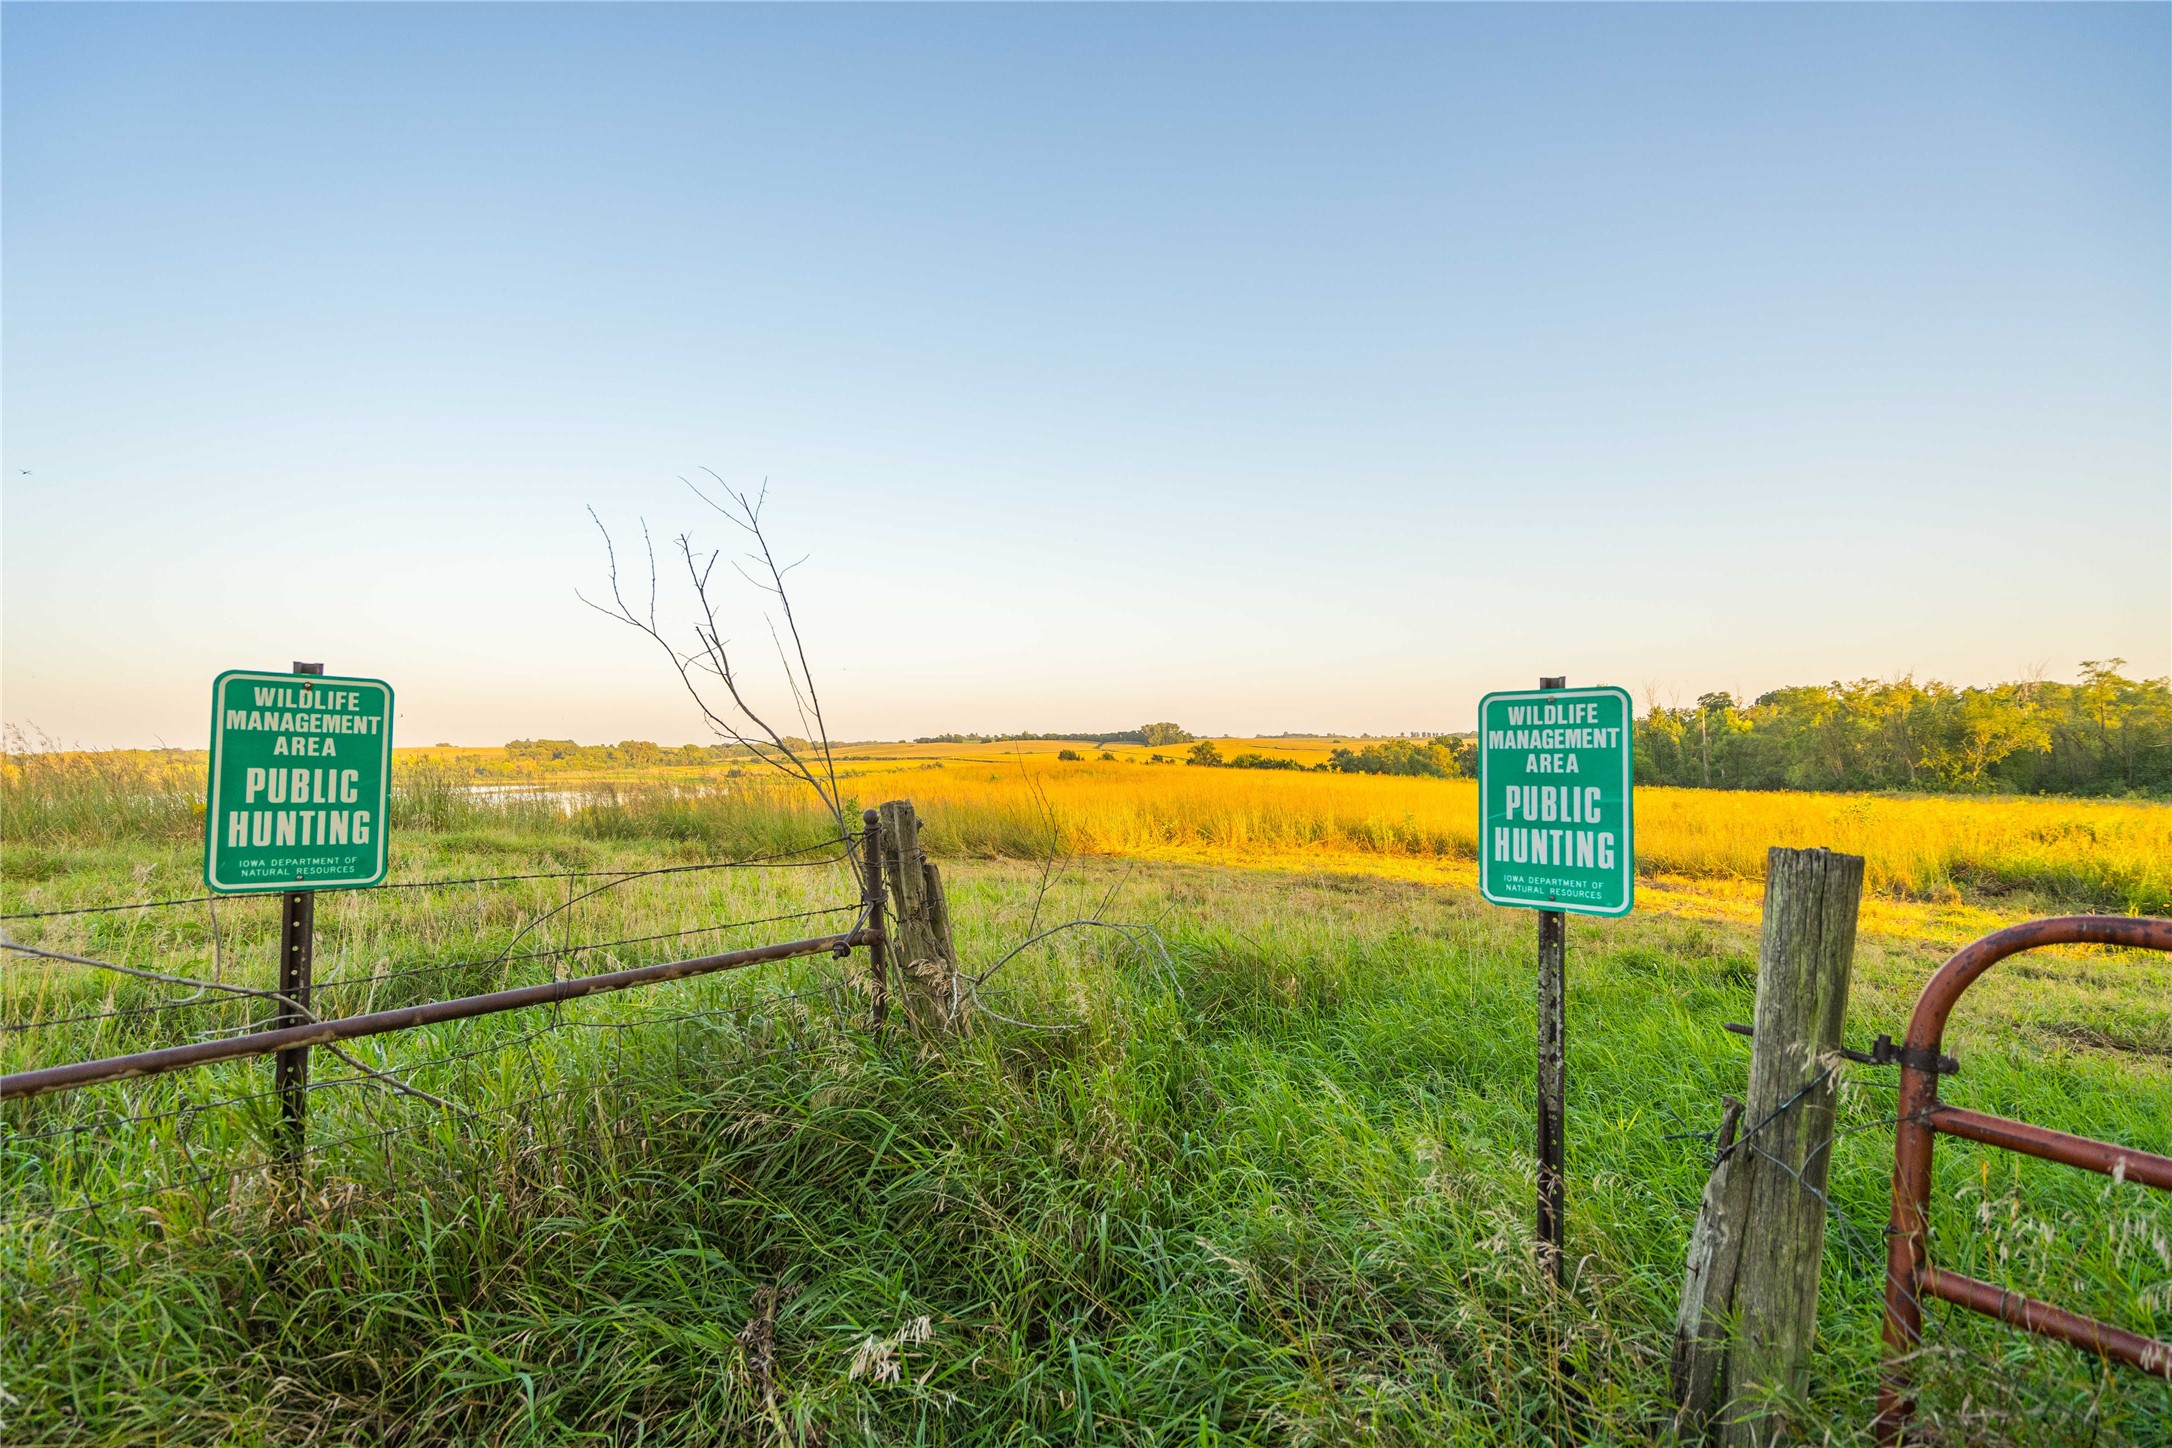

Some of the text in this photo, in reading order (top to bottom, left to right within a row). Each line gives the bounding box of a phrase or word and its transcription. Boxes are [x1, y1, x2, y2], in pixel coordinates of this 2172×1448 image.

[254, 687, 359, 711] WILDLIFE
[226, 710, 381, 734] MANAGEMENT
[1508, 704, 1598, 725] WILDLIFE
[274, 736, 336, 756] AREA
[1489, 728, 1620, 750] MANAGEMENT
[1526, 754, 1579, 773] AREA
[246, 768, 359, 803] PUBLIC
[1506, 785, 1601, 824] PUBLIC
[228, 810, 370, 847] HUNTING
[1495, 827, 1615, 869] HUNTING
[239, 859, 265, 867] IOWA
[271, 858, 339, 866] DEPARTMENT
[241, 866, 354, 877] NATURAL RESOURCES
[1504, 875, 1524, 883] IOWA
[1528, 876, 1587, 887] DEPARTMENT
[1506, 884, 1602, 899] NATURAL RESOURCES
